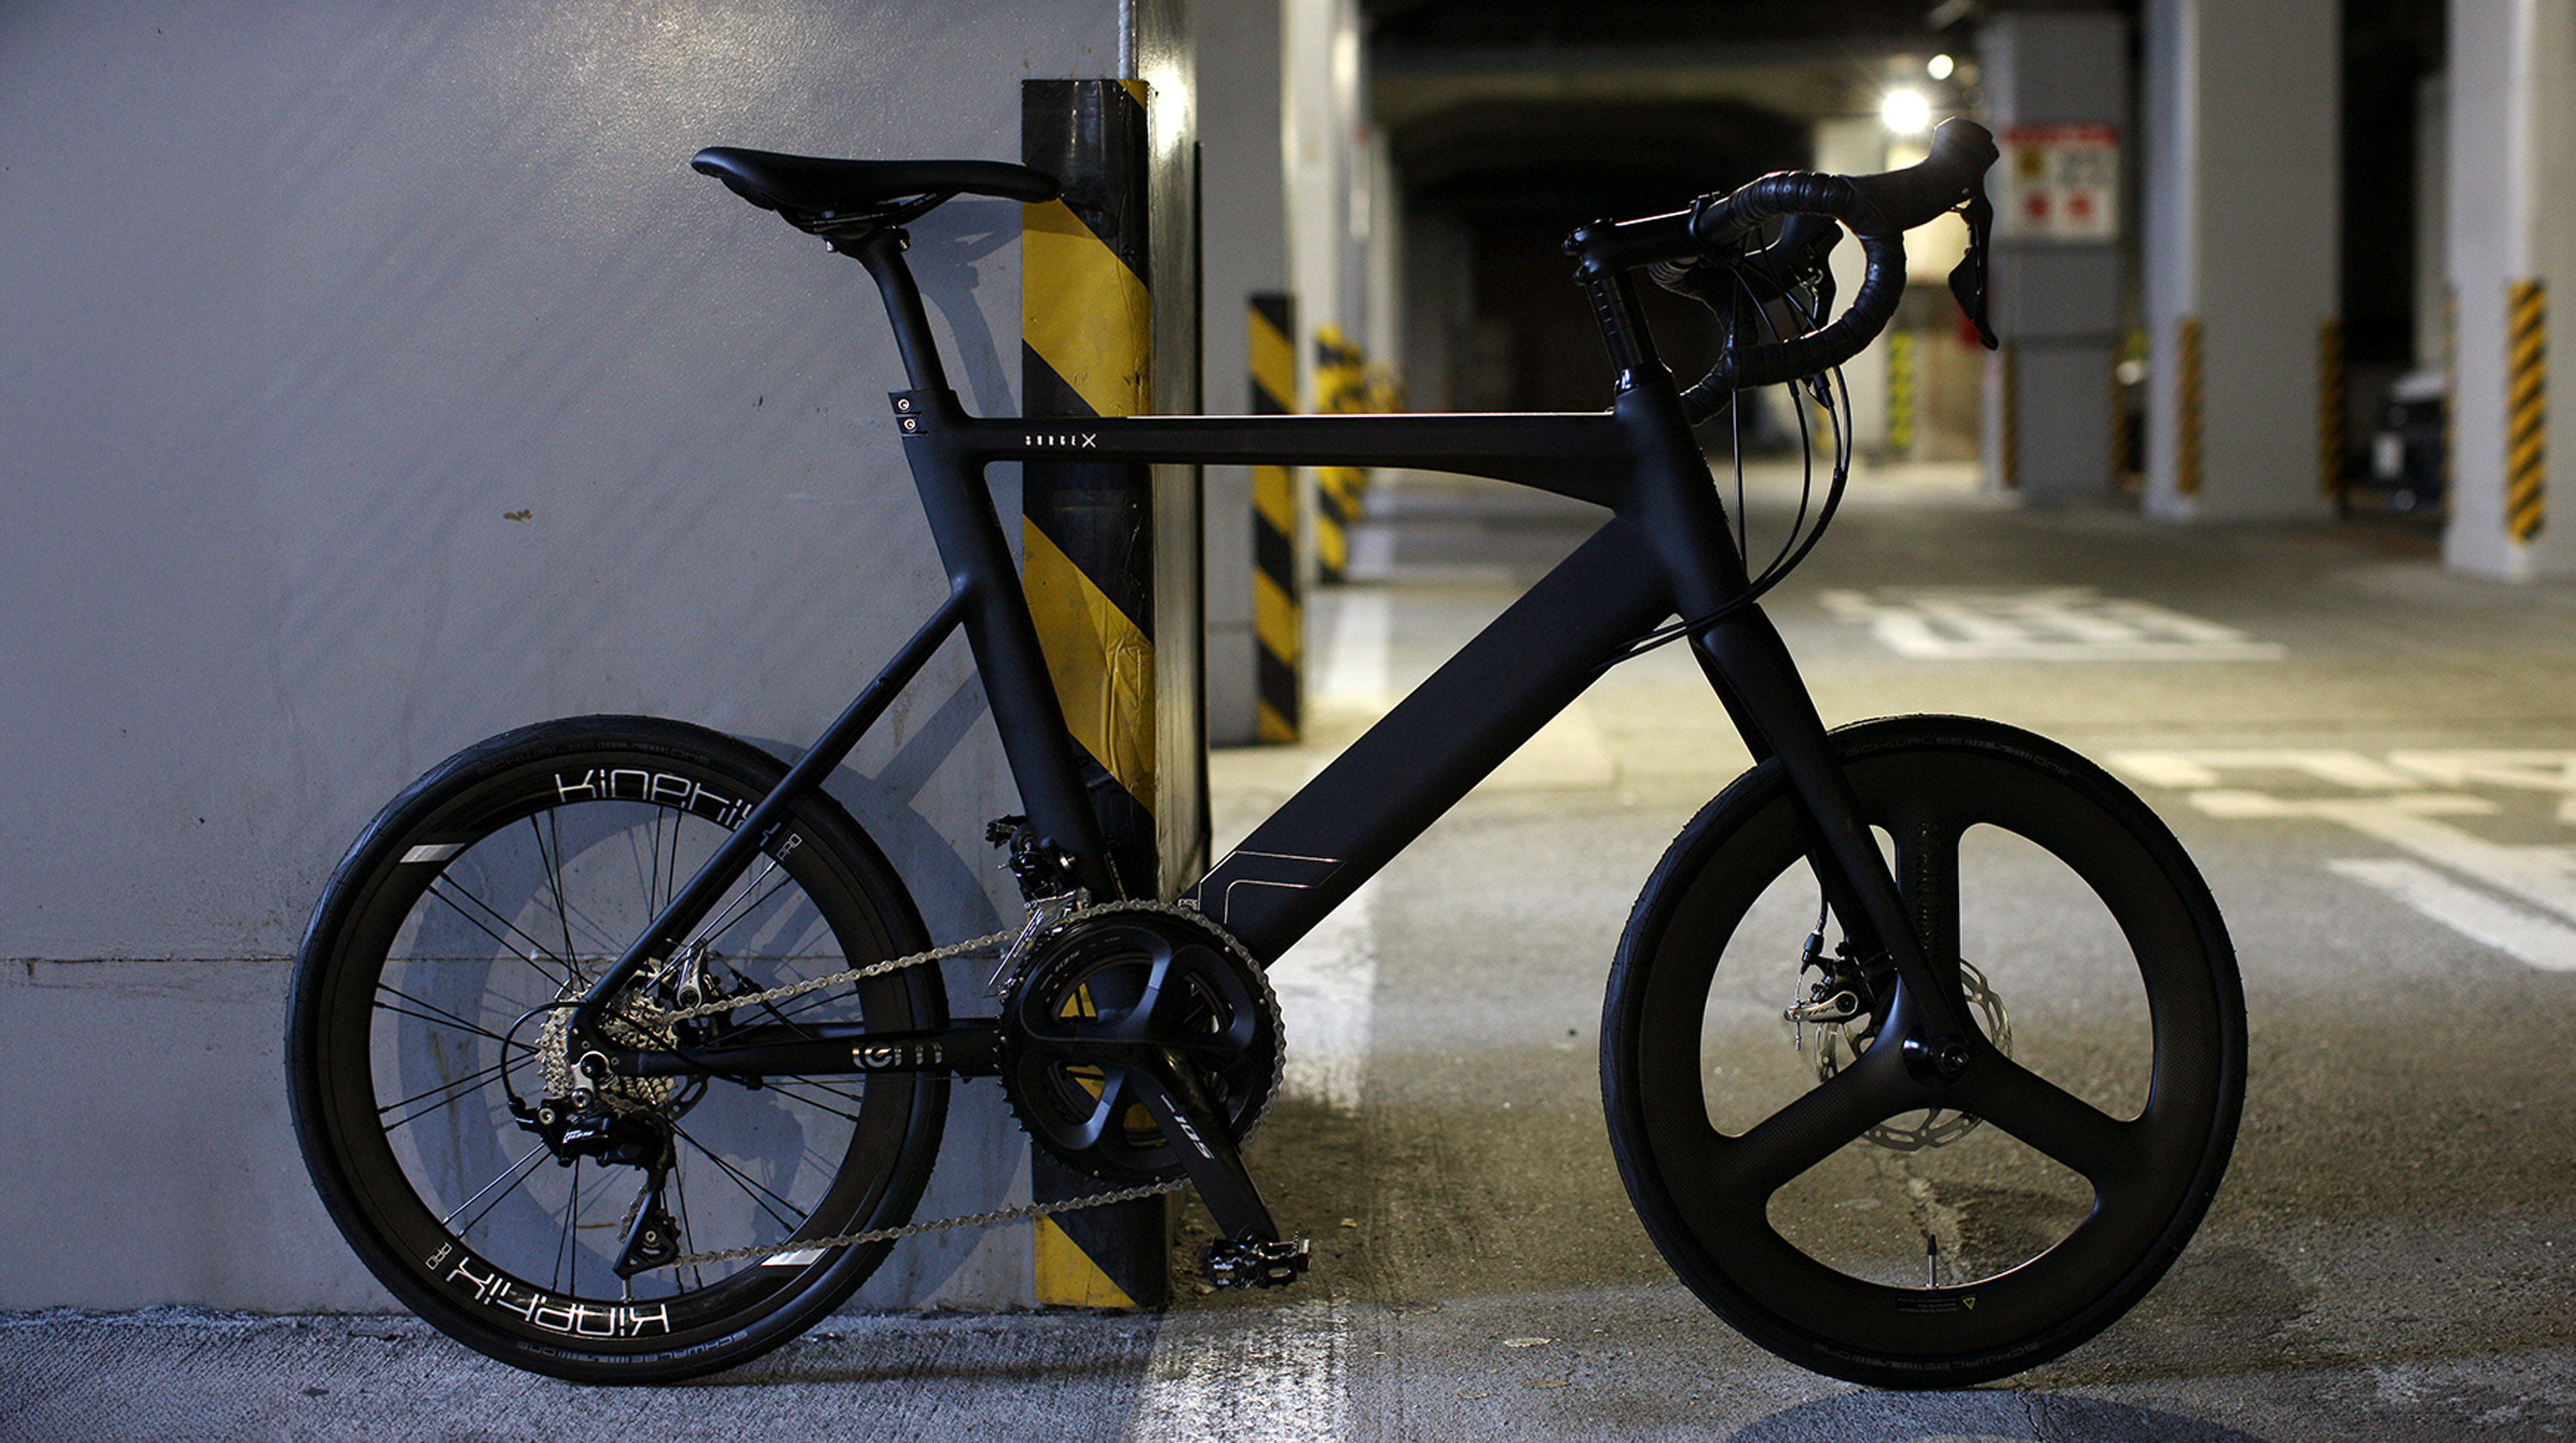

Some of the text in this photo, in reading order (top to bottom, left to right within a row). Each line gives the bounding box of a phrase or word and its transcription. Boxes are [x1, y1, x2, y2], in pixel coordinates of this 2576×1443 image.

[775, 833, 803, 859] PRO
[1173, 1115, 1216, 1160] 105
[424, 1242, 453, 1270] PRO
[630, 1336, 749, 1364] SCHWALBE
